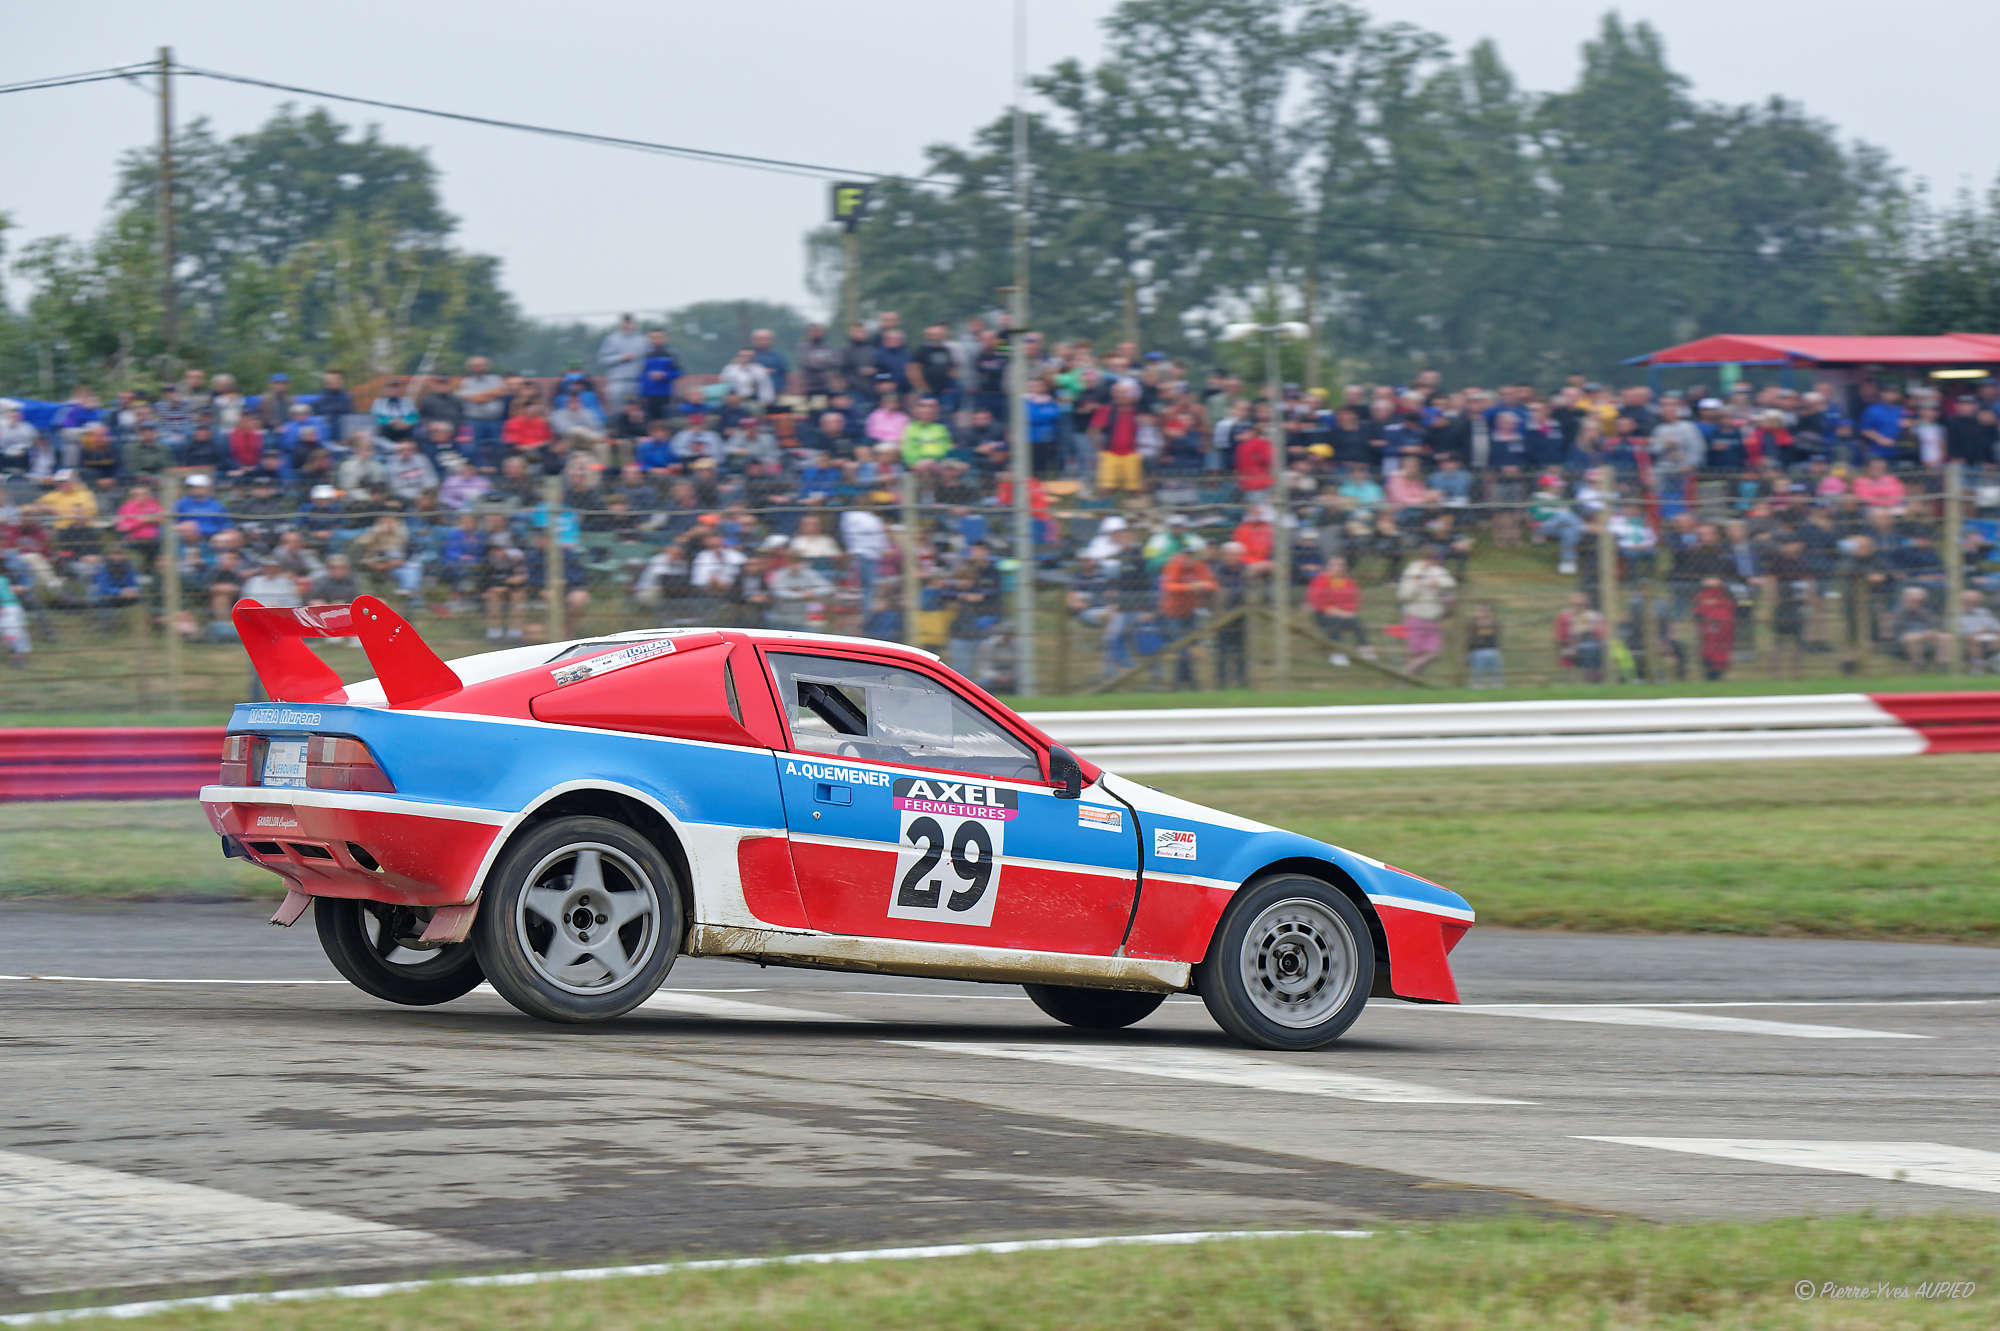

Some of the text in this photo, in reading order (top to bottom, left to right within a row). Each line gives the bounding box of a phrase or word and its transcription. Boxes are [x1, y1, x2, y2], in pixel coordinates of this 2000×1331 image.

[836, 187, 864, 215] F
[280, 709, 321, 726] Murena
[785, 761, 890, 787] A.QUEMENER
[906, 779, 1006, 808] AXEL
[904, 799, 1006, 820] FERMETURES
[1174, 832, 1195, 843] VAC
[897, 816, 994, 912] 29
